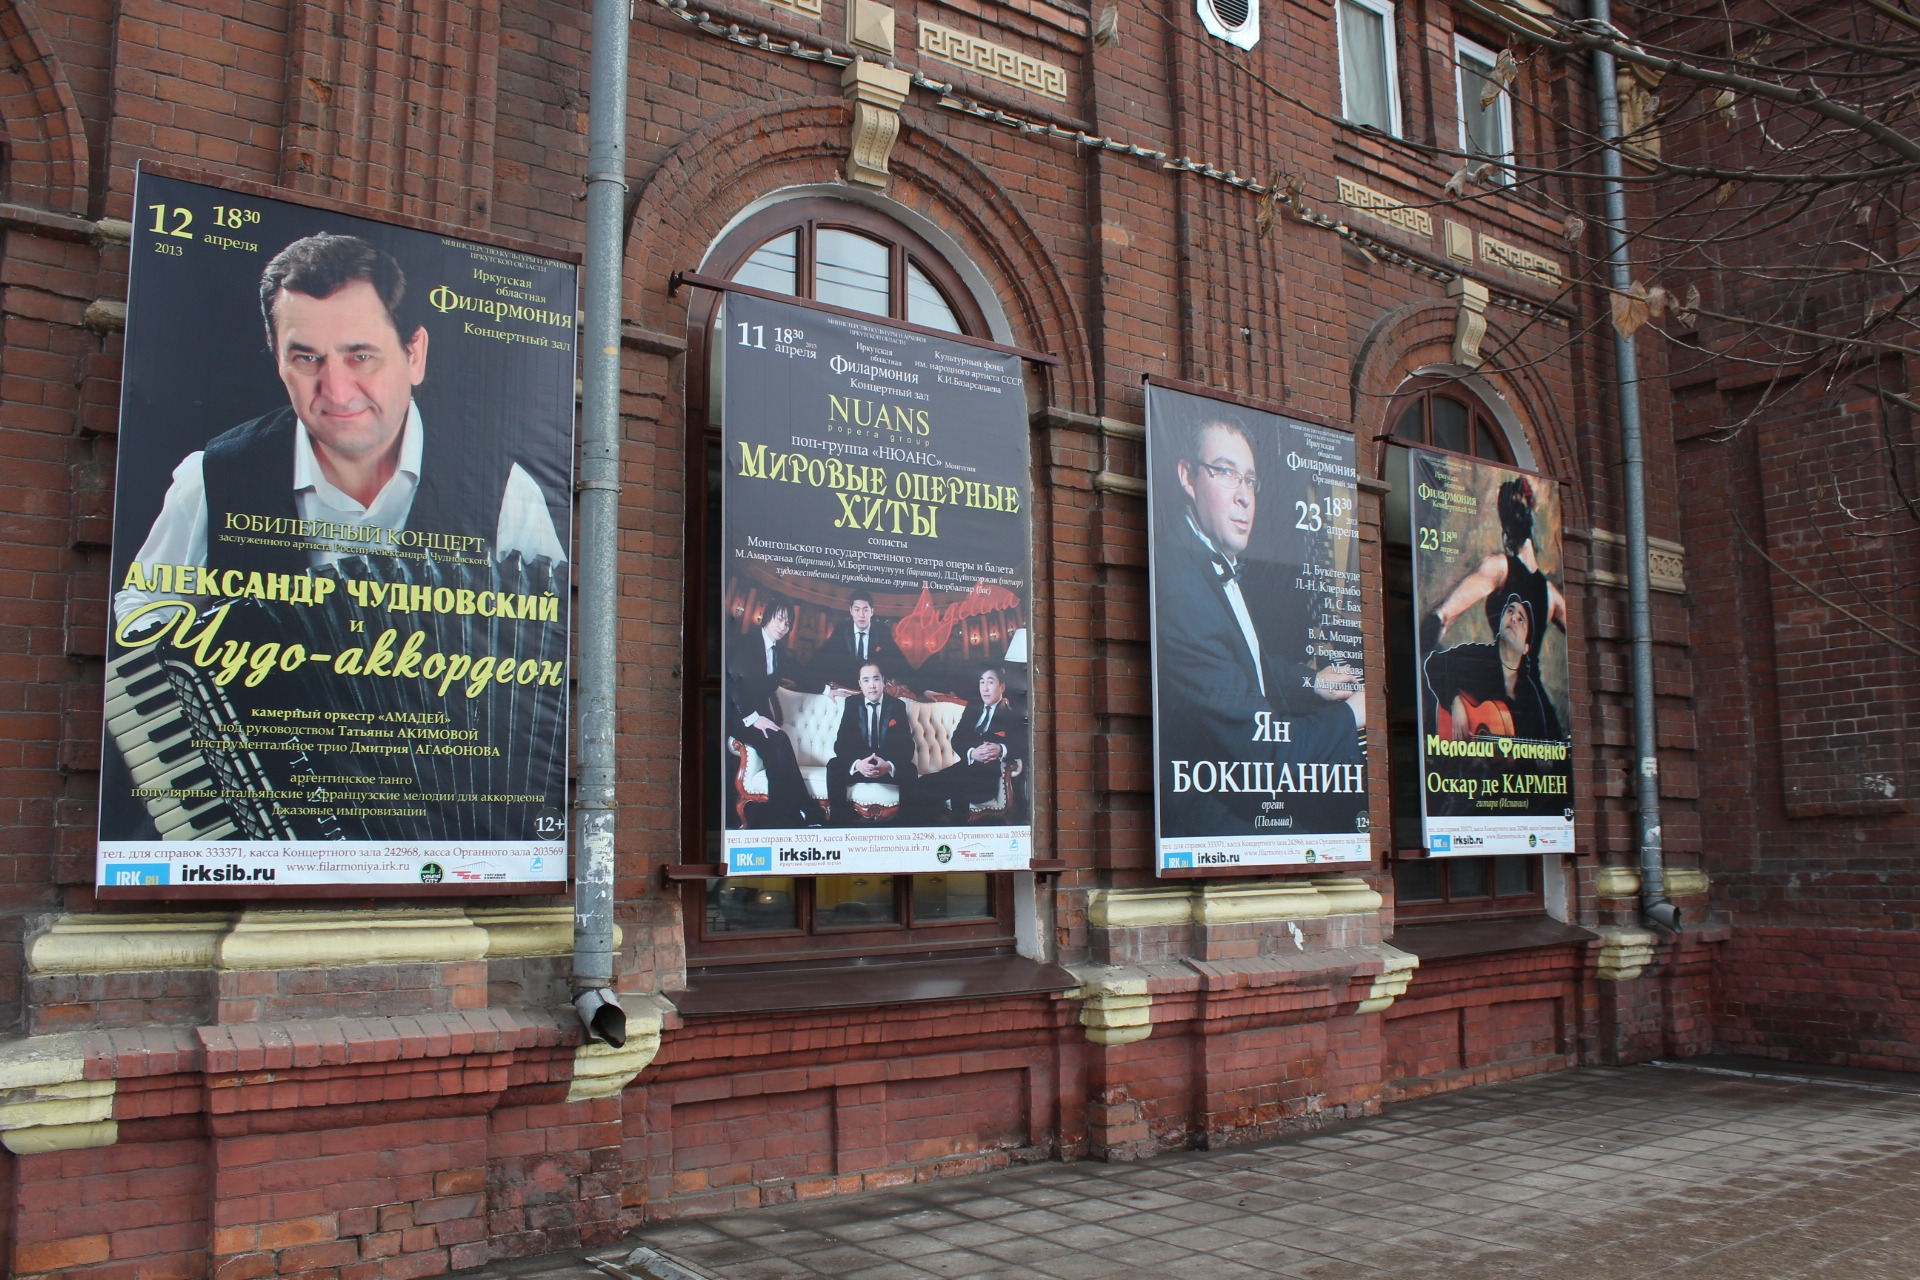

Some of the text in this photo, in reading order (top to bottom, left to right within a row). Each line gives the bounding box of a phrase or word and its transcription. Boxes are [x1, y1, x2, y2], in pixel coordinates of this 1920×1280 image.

[149, 204, 193, 239] 12
[155, 242, 182, 256] 2013
[204, 234, 258, 252] апреля
[441, 238, 498, 256] МИНИСТЕРСТВО
[499, 250, 536, 265] КУЛЬТУРЫ
[544, 258, 575, 271] АРХИВОВ
[470, 252, 546, 272] ИРКУТСКОЙ ОБЛАСТИ
[473, 268, 532, 289] Иркутская
[496, 286, 546, 304] областная
[429, 284, 572, 328] Филармония
[464, 322, 570, 351] Концертный зал
[738, 322, 766, 350] 11
[775, 343, 818, 359] апреля
[856, 342, 892, 356] Иркутская
[830, 354, 918, 384] Филармония
[934, 350, 1004, 372] Культурный фонд
[914, 360, 1022, 386] им. народного артиста СССР
[850, 378, 928, 402] Концертный зал
[828, 394, 930, 436] NUANS
[828, 424, 930, 447] popera group
[792, 435, 976, 473] поп-группа «НЮАНС» Монголия
[1286, 451, 1356, 478] Филармония
[1312, 473, 1356, 490] Органный зал
[1418, 482, 1476, 506] Филармония
[834, 492, 938, 538] ХИТЫ
[1295, 500, 1322, 532] 23
[224, 512, 485, 553] ЮБИЛЕЙНЫЙ КОНЦЕРТ
[1326, 525, 1359, 540] апреля
[1420, 526, 1439, 550] 23
[218, 534, 490, 566] заслуженного артиста России Александра Чудновского
[868, 537, 908, 548] солисты
[748, 536, 822, 554] Монгольского
[824, 546, 912, 563] государственного
[914, 557, 944, 570] театра
[946, 560, 974, 572] оперы
[984, 562, 1014, 574] балета
[776, 566, 840, 580] художественный
[842, 574, 892, 585] руководитель
[1314, 564, 1360, 582] Букстехуде
[122, 561, 559, 622] АЛЕКСАНДР ЧУДНОВСКИЙ
[1320, 582, 1360, 597] Клерамбо
[1347, 600, 1362, 612] Бах
[1332, 615, 1362, 628] Беннет
[1330, 630, 1362, 646] Моцарт
[115, 600, 563, 700] Чудо-аккордеон
[1344, 664, 1364, 676] Сава
[1316, 678, 1365, 692] Мартинсон
[252, 708, 450, 724] камерный оркестр «АМАДЕЙ»
[218, 724, 478, 740] под руководством Татьяны АКИМОВОЙ
[1252, 711, 1290, 743] Ян
[191, 740, 500, 757] инструментальное трио Дмитрия АГАФОНОВА
[1427, 734, 1566, 761] Мелодии Фламенко
[290, 774, 412, 786] аргентинское танго
[1172, 760, 1364, 800] БОКЩАНИН
[1427, 772, 1568, 800] Оскар де КАРМЕН
[131, 788, 218, 801] популярные
[221, 789, 304, 800] итальянские
[318, 790, 400, 803] французские
[404, 793, 454, 802] мелодии
[458, 794, 478, 802] для
[480, 794, 544, 804] аккордеона
[1476, 800, 1498, 810] гитара
[272, 806, 426, 818] джазовые импровизации
[1262, 801, 1284, 814] орган
[536, 816, 564, 832] 12+
[1254, 814, 1292, 830] (Польша)
[744, 836, 758, 844] для
[761, 836, 792, 845] справок
[845, 834, 894, 843] Концертного
[958, 832, 994, 842] Органного
[1453, 835, 1483, 845] irksib.ru
[102, 846, 564, 860] тел. для справок 333371, касса Концертного зала 242968, касса Органного зала 203569
[780, 848, 840, 862] irksib.ru
[1198, 852, 1240, 864] irksib.ru
[182, 864, 276, 882] irksib.ru
[286, 861, 410, 872] www.filarmoniya.irk.ru
